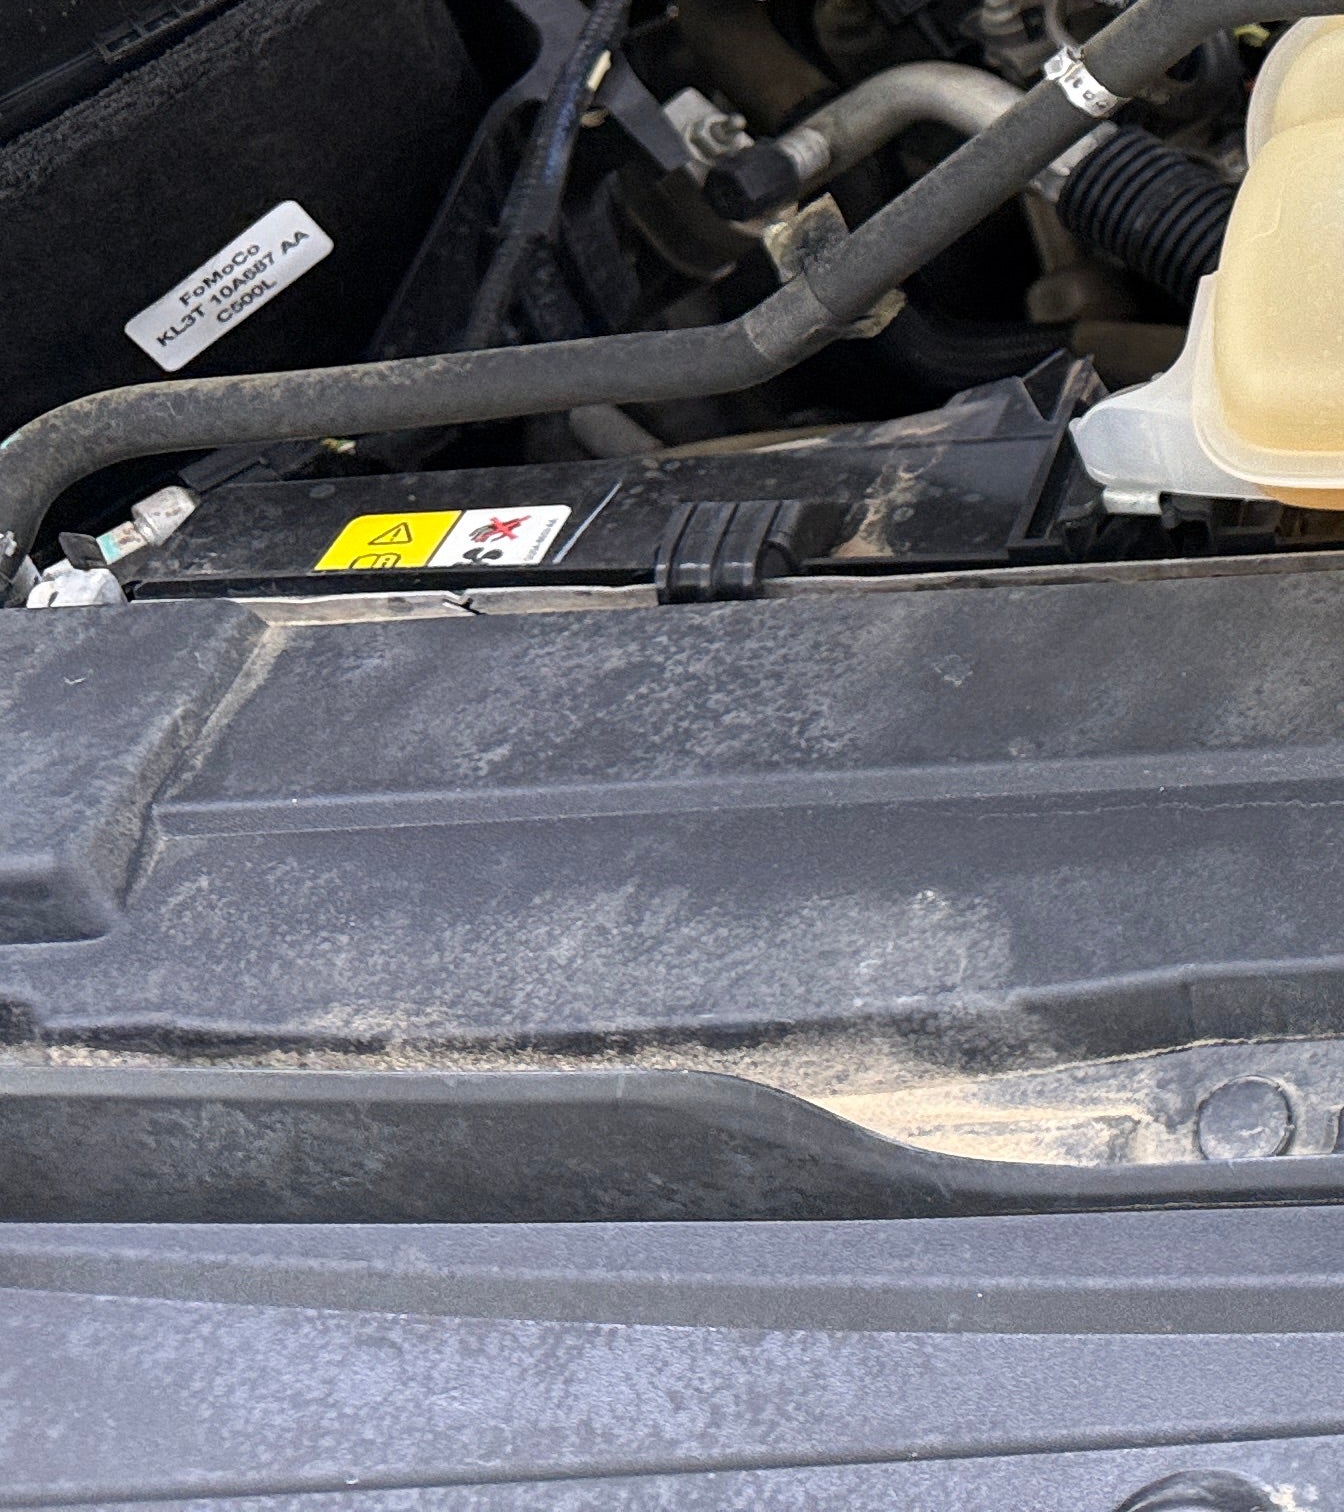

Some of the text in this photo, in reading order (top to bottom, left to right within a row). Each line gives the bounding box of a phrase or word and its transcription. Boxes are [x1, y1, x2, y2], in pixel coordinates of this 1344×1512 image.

[156, 303, 206, 348] KL3T
[279, 230, 310, 255] AA
[179, 244, 261, 306] FoMoCo
[216, 279, 278, 324] C500L
